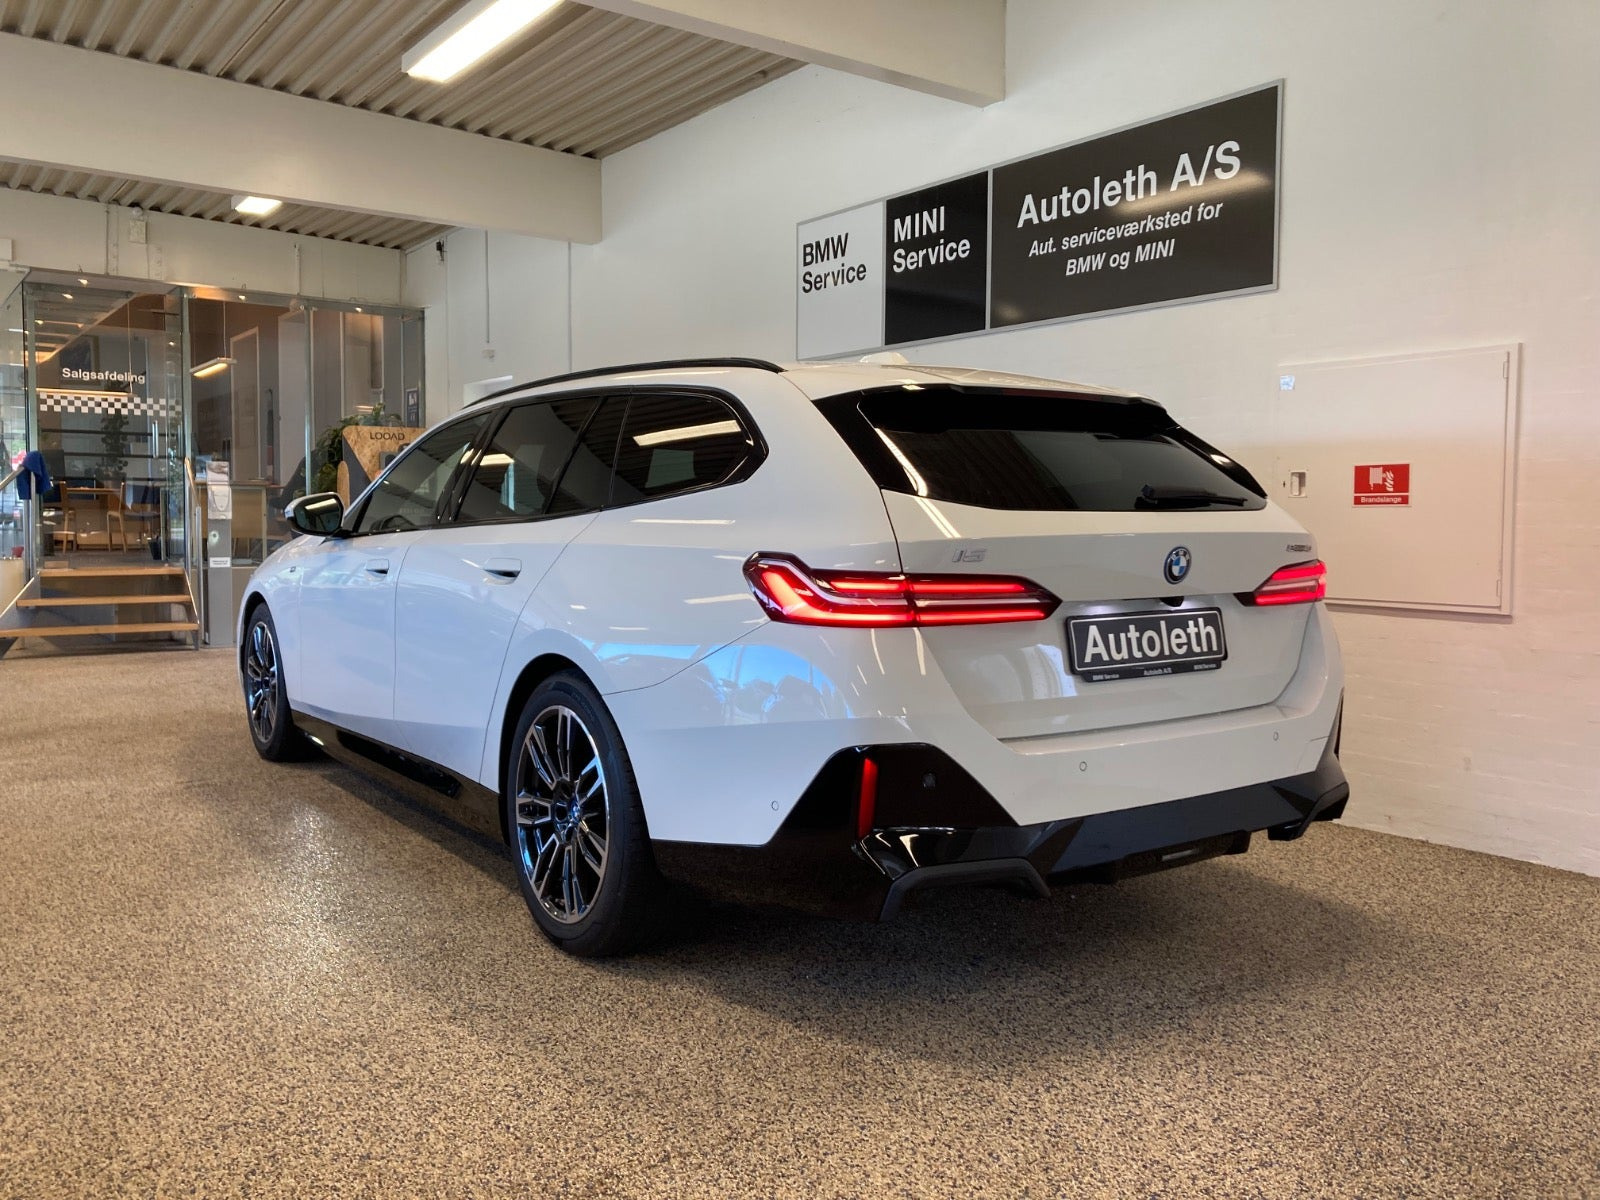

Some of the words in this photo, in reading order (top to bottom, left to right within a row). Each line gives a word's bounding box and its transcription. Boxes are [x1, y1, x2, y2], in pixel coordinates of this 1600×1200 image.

[1016, 164, 1157, 228] Autoleth
[1170, 140, 1241, 192] A/S
[894, 206, 945, 243] MINI
[1028, 237, 1057, 258] Aut.
[1061, 205, 1193, 251] serviceværksted
[1197, 202, 1224, 222] for
[802, 232, 849, 267] BMW
[892, 238, 971, 273] Service
[1065, 252, 1107, 277] BMW
[1109, 251, 1130, 270] og
[1135, 238, 1176, 264] MINI
[802, 262, 867, 293] Service
[62, 367, 146, 385] Salgsafdeling
[1360, 496, 1402, 504] Brandslange
[1084, 617, 1218, 663] Autoleth
